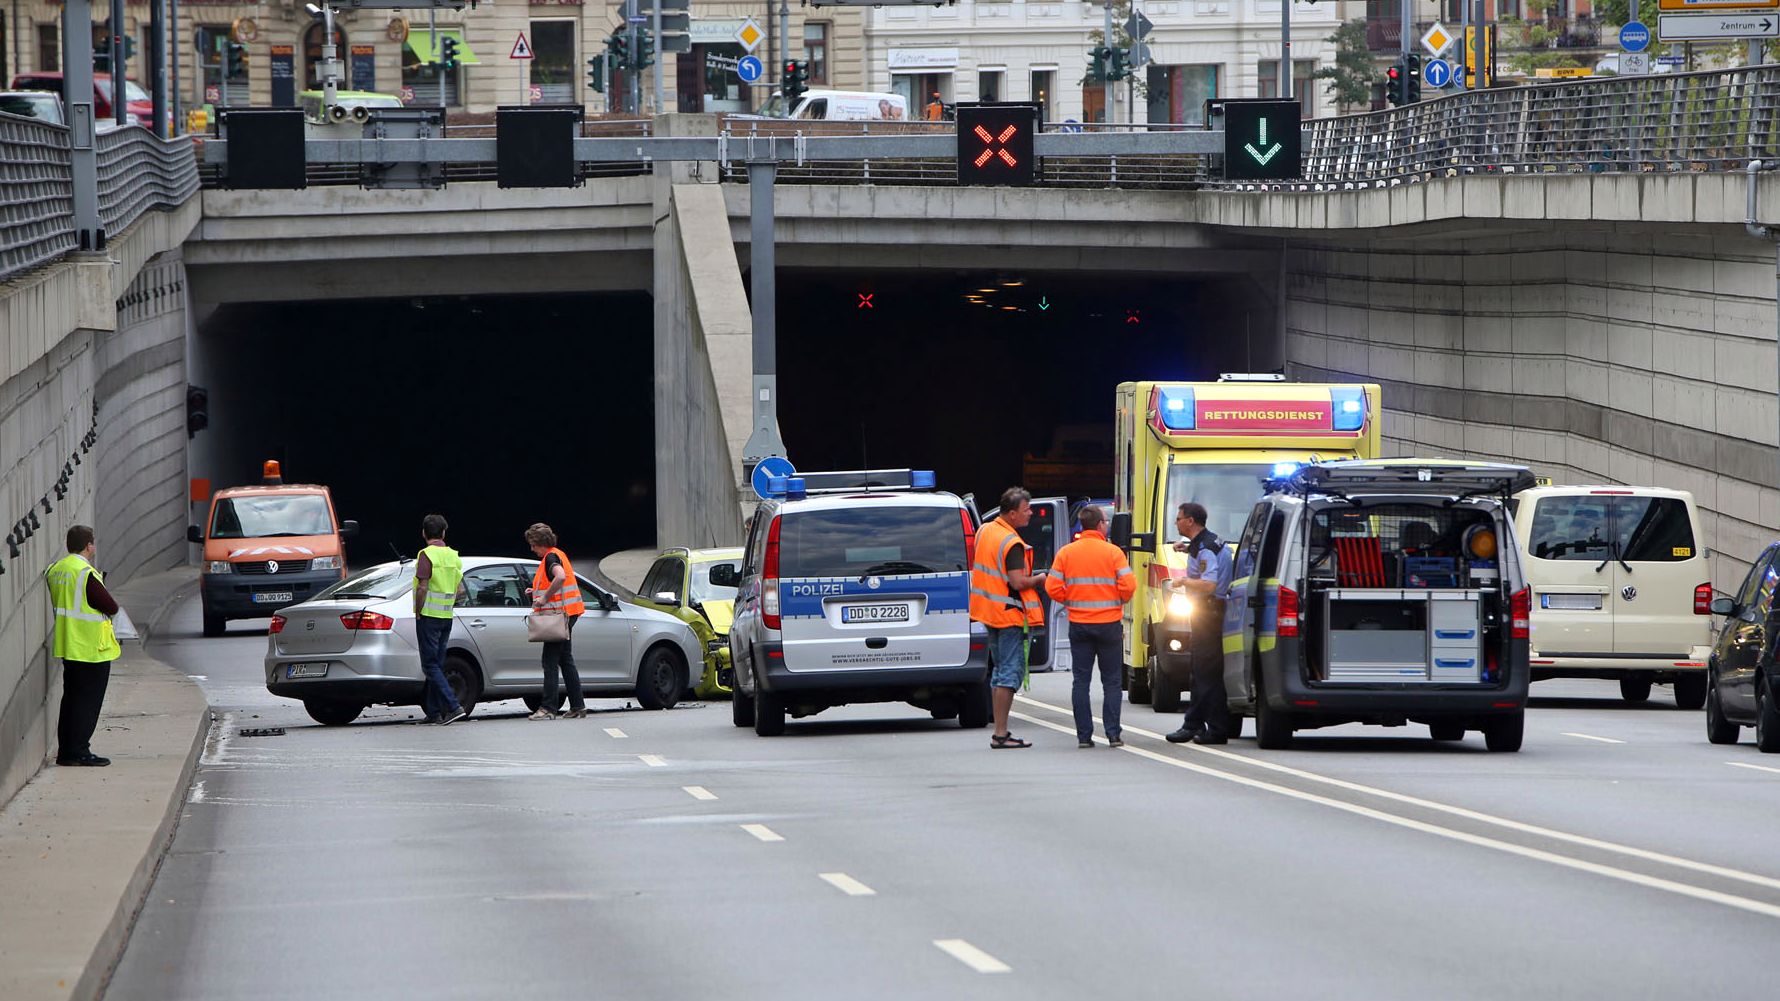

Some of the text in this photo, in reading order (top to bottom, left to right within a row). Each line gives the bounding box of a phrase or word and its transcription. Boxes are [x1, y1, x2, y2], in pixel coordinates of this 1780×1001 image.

[1720, 22, 1756, 30] Zentrum
[1204, 410, 1324, 421] RETTUNGSDIENST
[1674, 548, 1689, 556] 4121
[792, 584, 844, 596] POLIZEI
[850, 606, 907, 619] DD Q 2228
